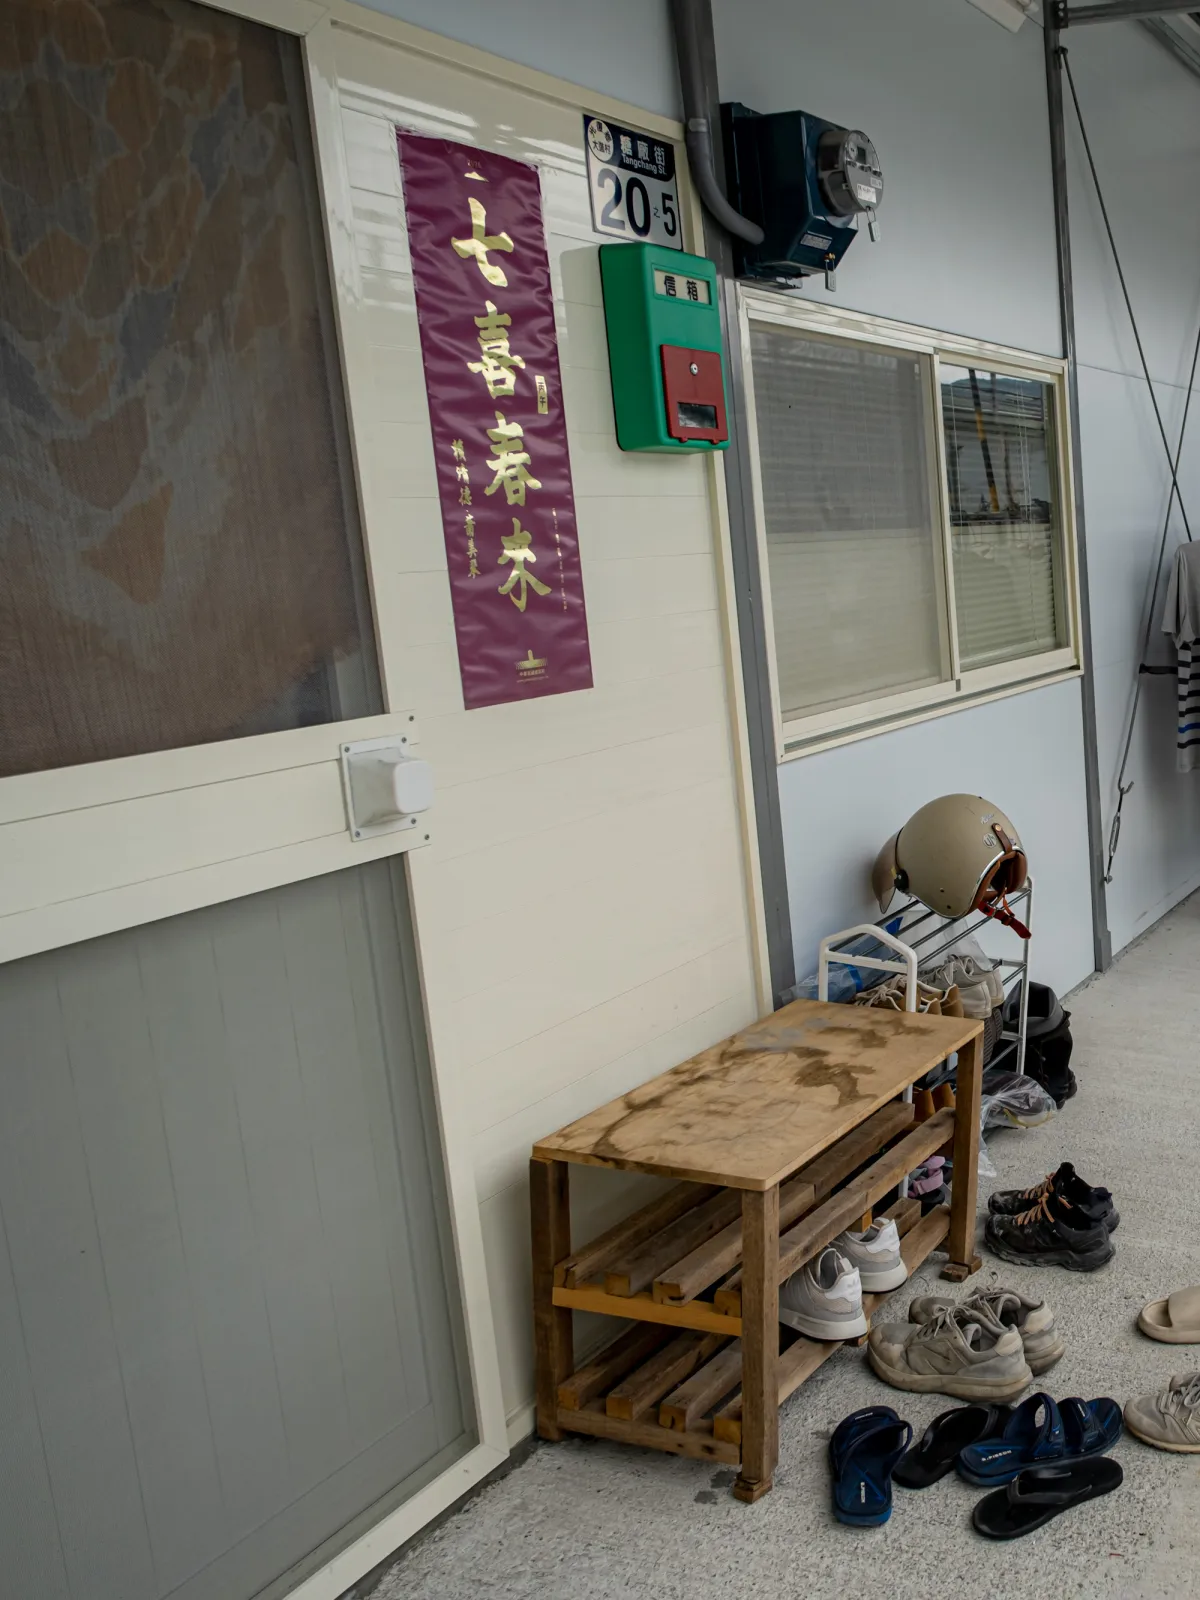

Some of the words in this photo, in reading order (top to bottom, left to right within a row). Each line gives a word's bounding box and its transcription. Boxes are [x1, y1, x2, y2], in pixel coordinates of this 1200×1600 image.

[620, 135, 666, 166] 糖廠街
[622, 153, 657, 175] Tangchang
[664, 275, 699, 301] 信箱
